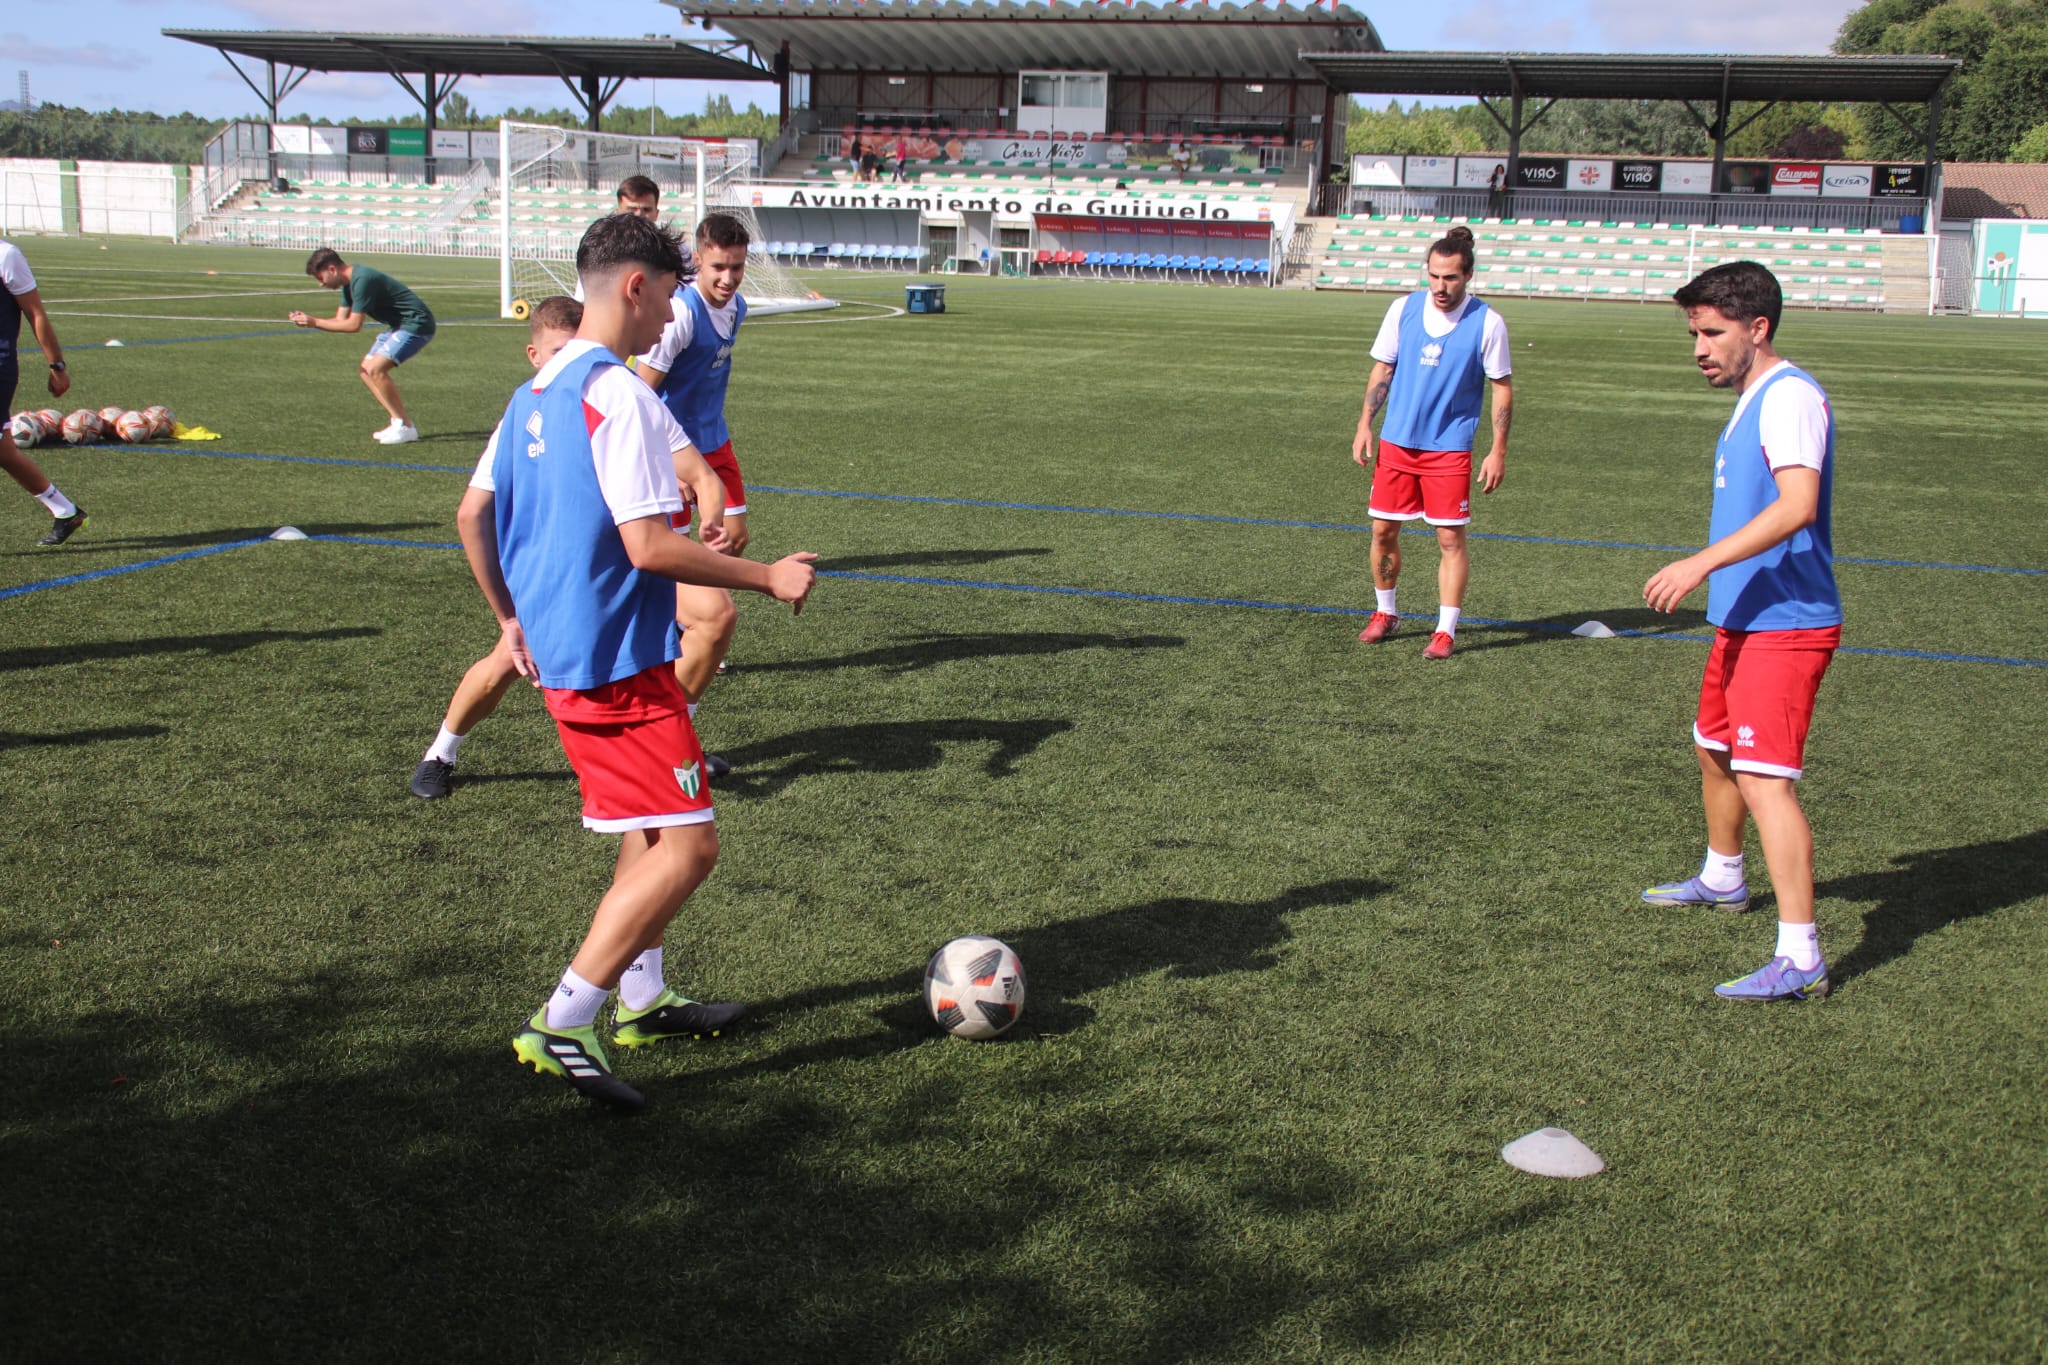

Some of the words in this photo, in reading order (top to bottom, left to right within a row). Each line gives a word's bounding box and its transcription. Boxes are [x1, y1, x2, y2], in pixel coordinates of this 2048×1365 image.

[789, 190, 1022, 214] Ayuntamiento
[1035, 197, 1073, 213] de
[1086, 199, 1230, 220] Guijuelo
